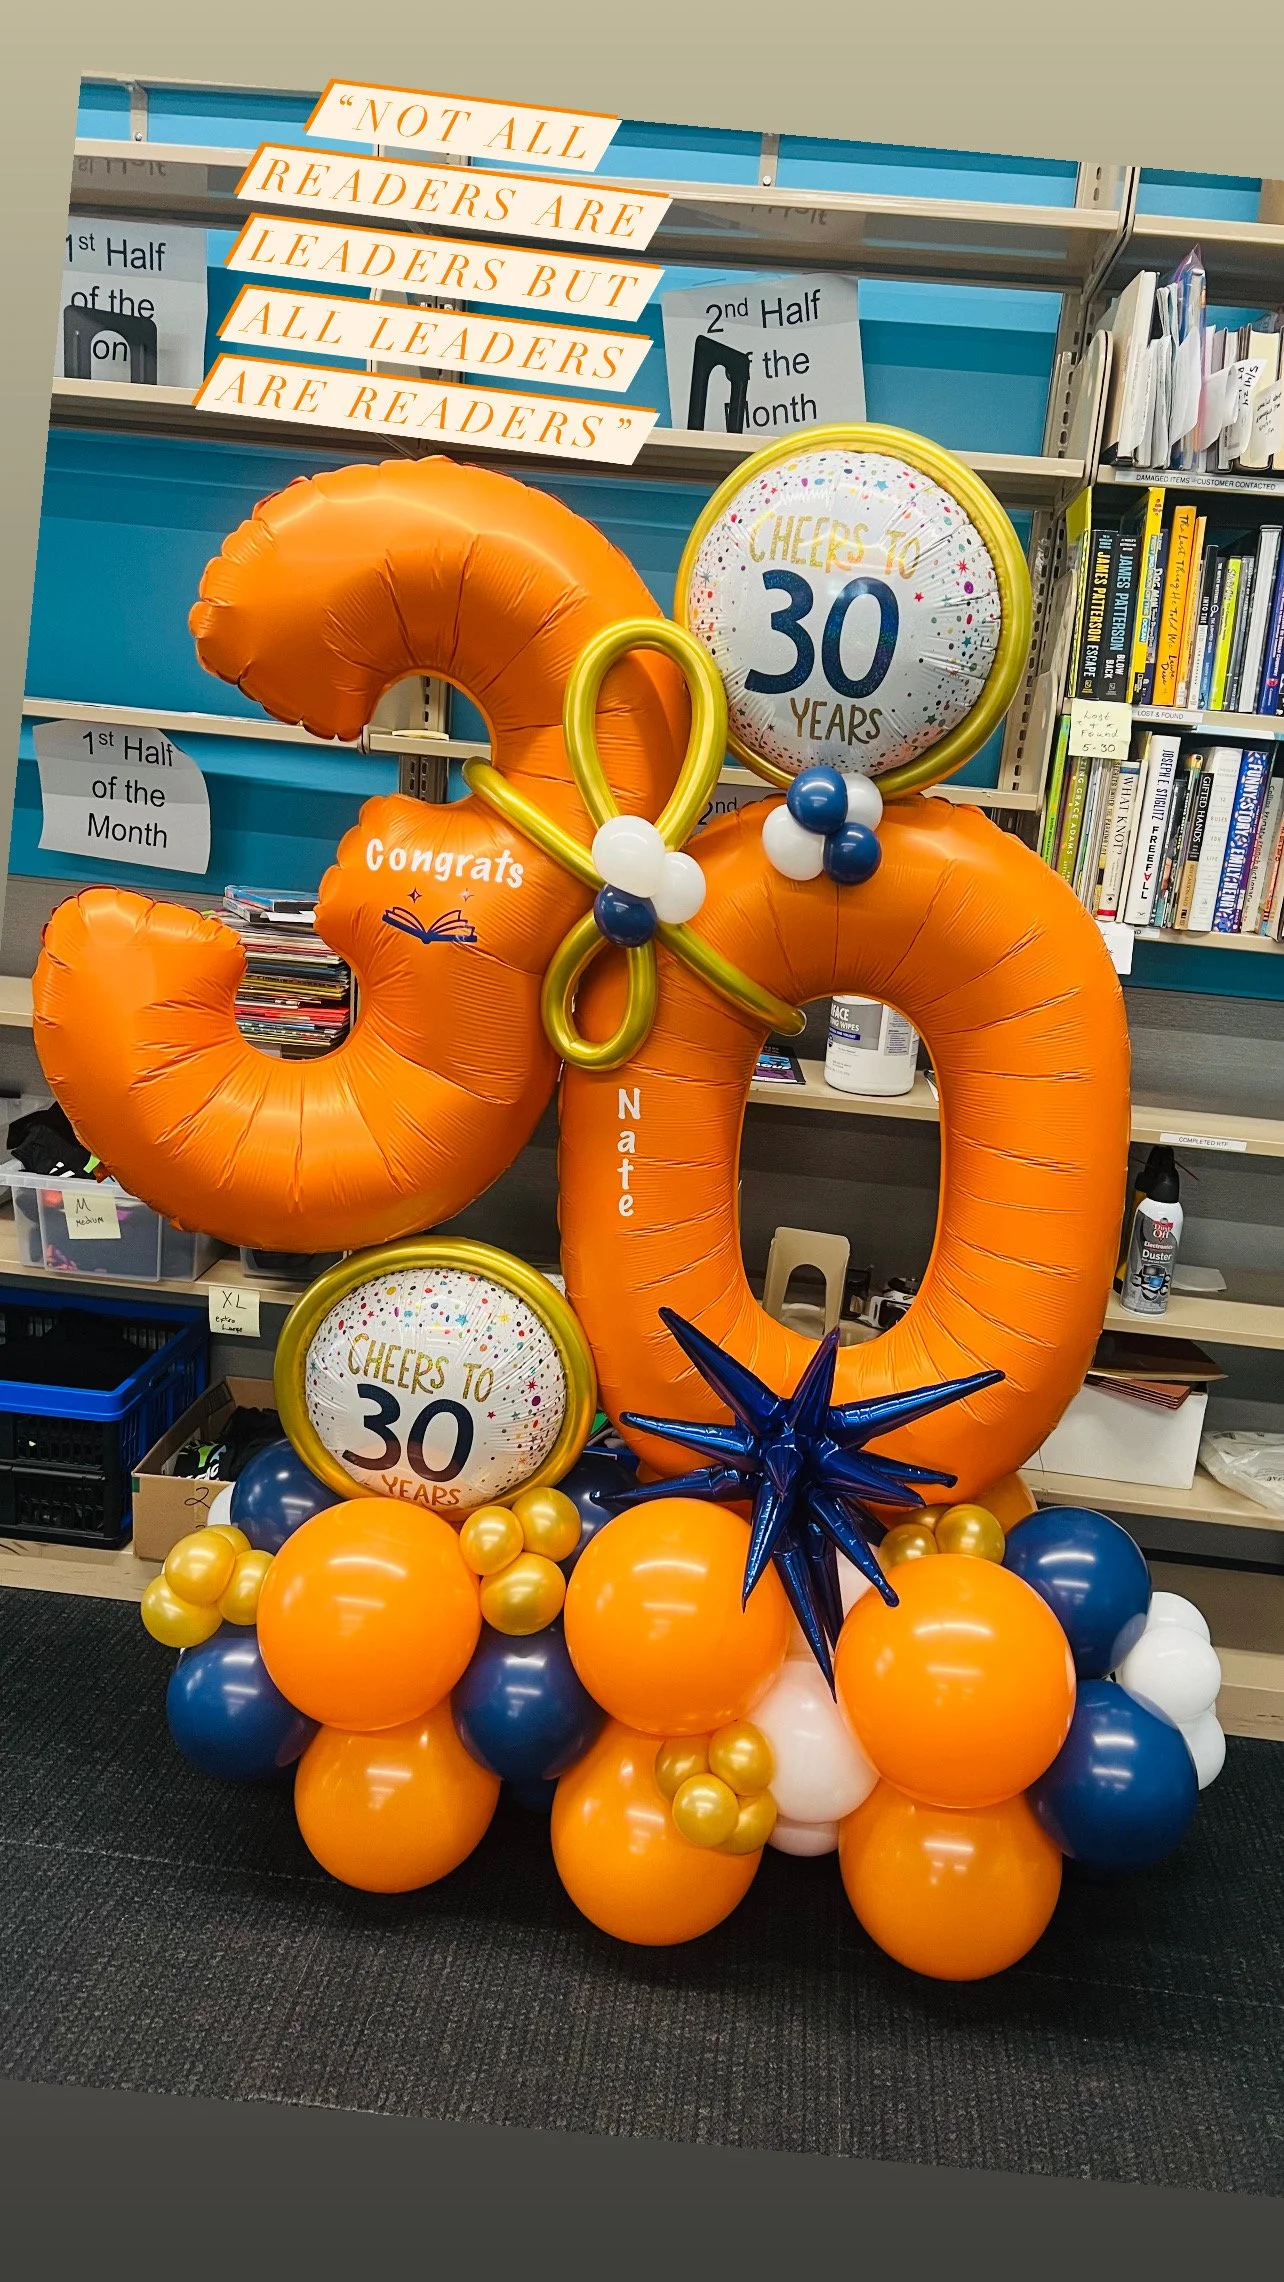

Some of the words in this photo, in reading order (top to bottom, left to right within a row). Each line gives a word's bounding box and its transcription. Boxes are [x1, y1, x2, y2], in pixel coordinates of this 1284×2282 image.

[66, 232, 96, 262] 1st
[106, 237, 167, 272] Half
[109, 289, 155, 319] the
[705, 297, 748, 334] 2nd
[760, 289, 821, 329] Half
[762, 349, 810, 379] the
[1136, 474, 1168, 483] DAMAGED
[1170, 476, 1190, 484] ITEMS
[1197, 478, 1234, 487] CUSTOMER
[1235, 481, 1276, 490] CONTACTED
[1178, 515, 1189, 532] The
[748, 508, 869, 574] CHEERS
[883, 529, 922, 580] TO
[1178, 535, 1189, 556] Last
[1094, 551, 1111, 585] JAMES
[1116, 554, 1133, 589] JAMES
[1170, 560, 1185, 588] Thing
[1170, 592, 1182, 605] He
[1201, 596, 1210, 611] INTO
[1087, 587, 1107, 645] PATTERSON
[1110, 592, 1130, 651] PATTERSON
[1140, 618, 1149, 642] OCEAN
[1168, 607, 1178, 632] Told
[744, 568, 900, 699] 30
[1167, 633, 1178, 649] Me
[1083, 645, 1099, 678] ESCAPE
[1104, 659, 1115, 679] BACK
[1115, 653, 1126, 676] BLOW
[789, 697, 884, 747] YEARS
[1084, 710, 1111, 721] Lost
[1161, 712, 1184, 720] FOUND
[83, 731, 114, 755] 1st
[124, 735, 173, 767] Half
[1081, 729, 1119, 738] Found
[1159, 749, 1175, 778] JOSEPH
[92, 776, 118, 800] of
[125, 779, 166, 807] the
[1120, 776, 1134, 810] WHAT
[1199, 776, 1211, 808] GIFTED
[1242, 764, 1263, 799] FUNNY
[1265, 785, 1274, 808] Collins
[1072, 788, 1083, 819] GRACE
[1152, 788, 1168, 821] STIGLITZ
[1235, 802, 1255, 836] STORY
[88, 812, 167, 848] Month
[1066, 823, 1077, 855] ADAMS
[1112, 815, 1128, 855] KNOT?
[1192, 810, 1206, 843] HANDS
[365, 838, 525, 890] Congrats
[1140, 825, 1160, 900] FREEFALL
[1225, 848, 1245, 880] EMILY
[1218, 882, 1239, 914] HENRY
[840, 1021, 860, 1032] WIPES
[617, 1087, 642, 1217] Nate
[1178, 1137, 1215, 1146] COMPLETED
[75, 1197, 91, 1214] M
[1153, 1230, 1169, 1239] Off
[1142, 1249, 1172, 1261] Duster
[221, 1290, 247, 1310] XL
[347, 1332, 449, 1395] CHEERS
[462, 1361, 495, 1403] TO
[341, 1383, 475, 1483] 30
[381, 1474, 462, 1506] YEARS
